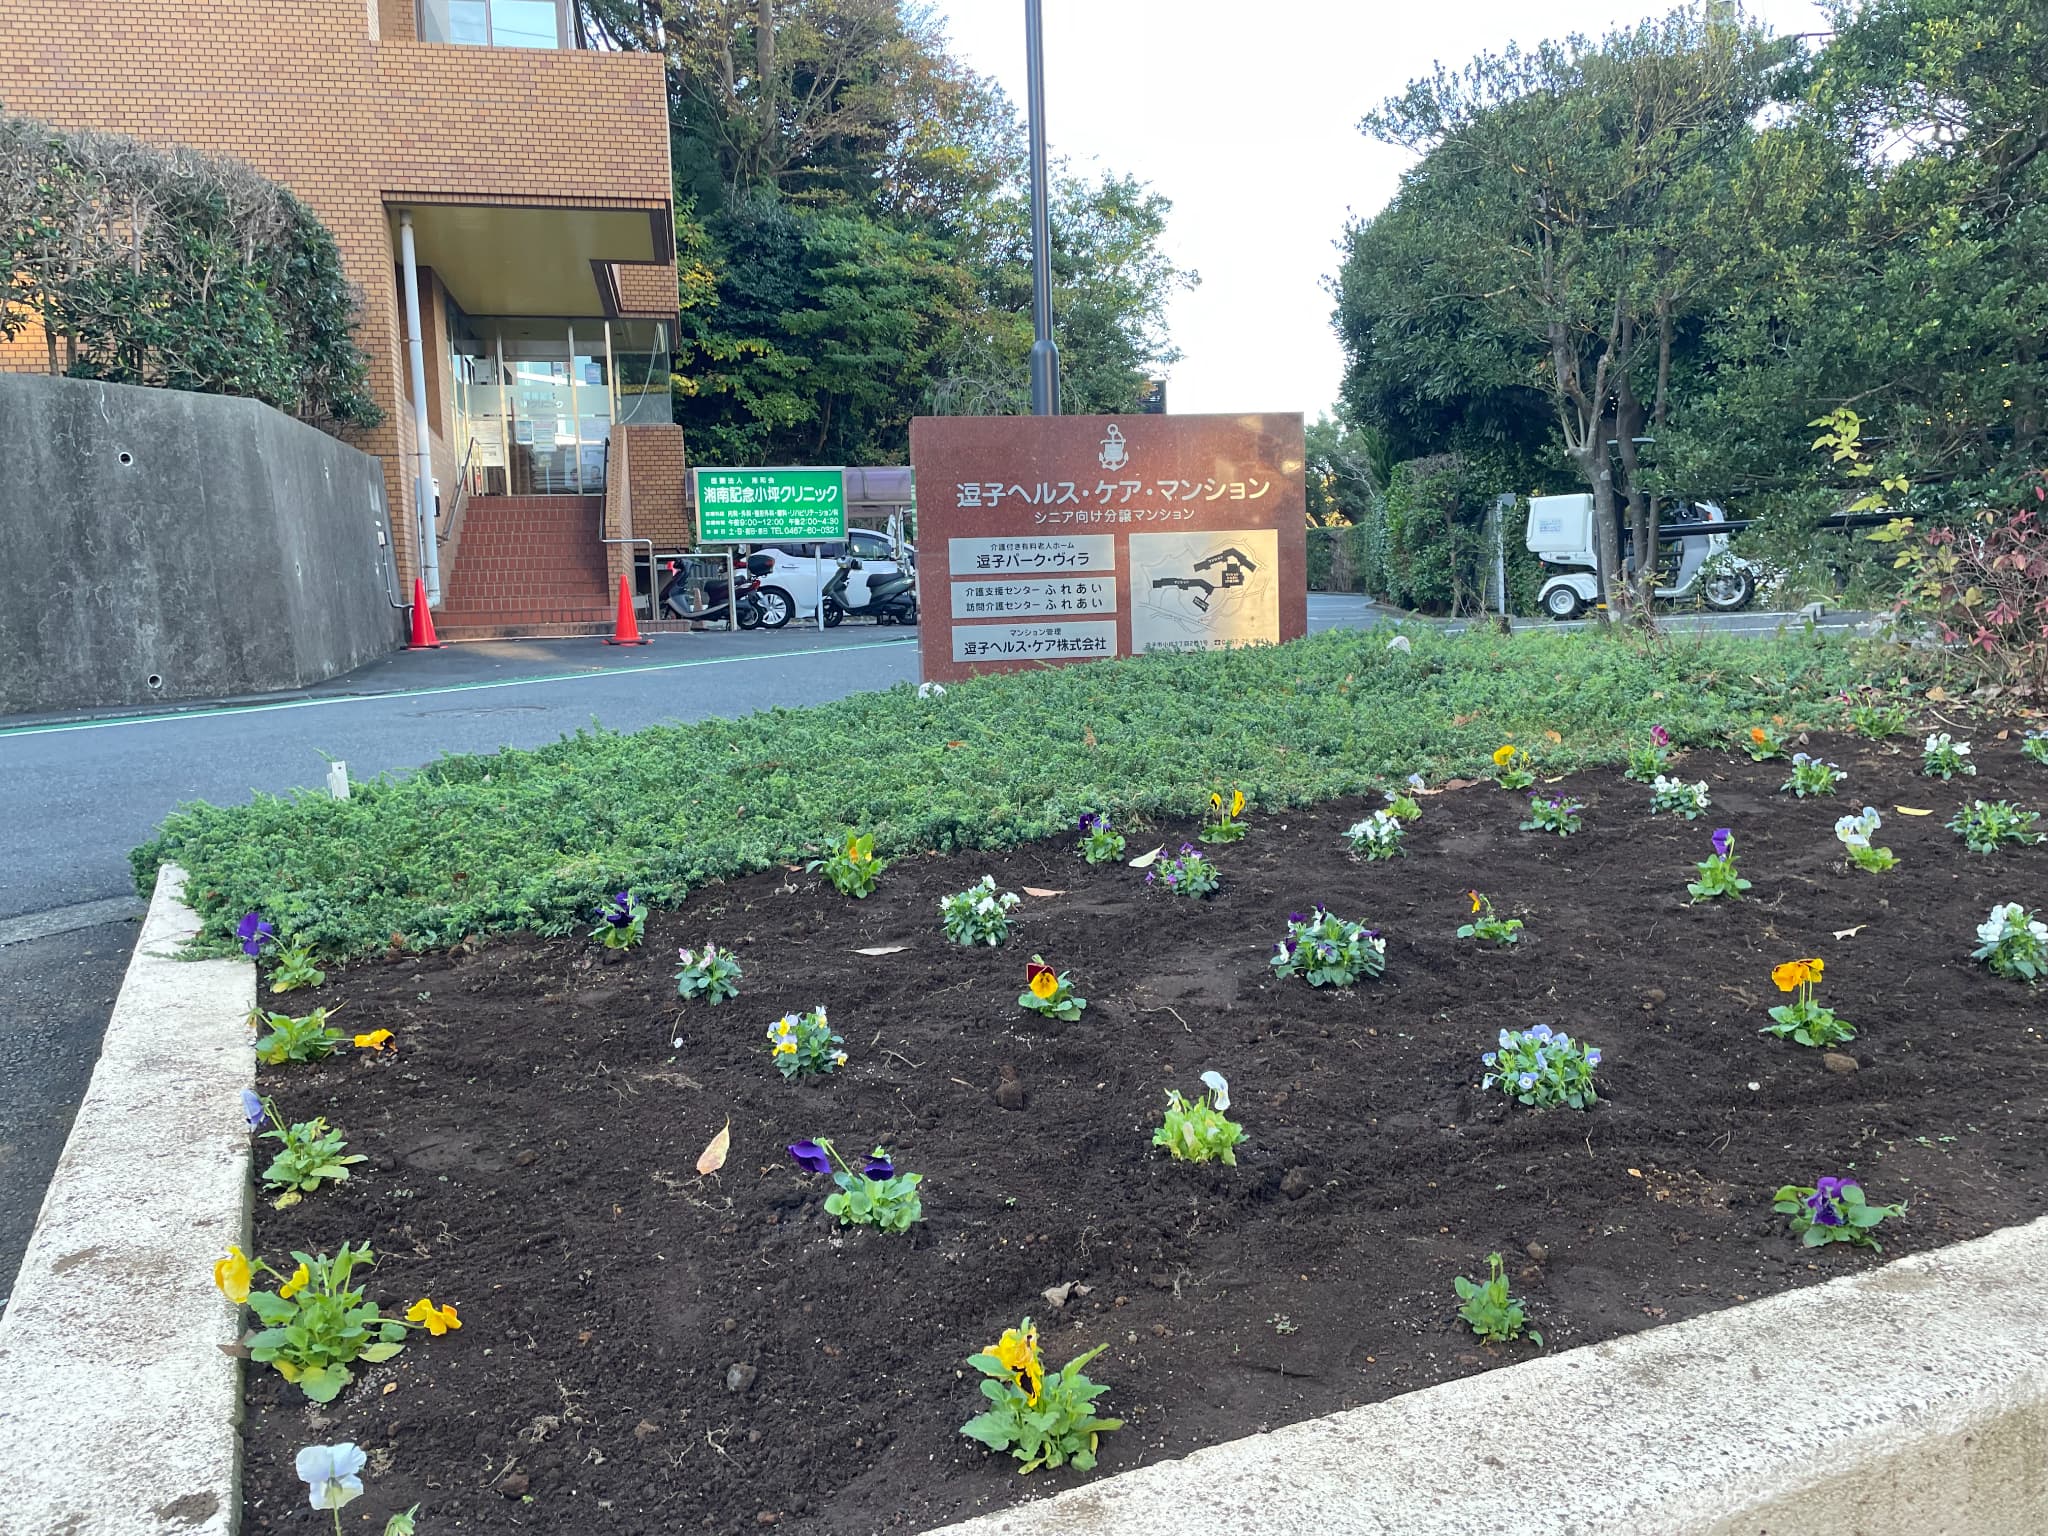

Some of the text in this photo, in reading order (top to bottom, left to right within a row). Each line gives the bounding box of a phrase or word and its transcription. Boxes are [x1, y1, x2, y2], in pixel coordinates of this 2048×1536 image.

[703, 485, 838, 504] 湘南記念小坪クリニック
[956, 477, 1271, 509] 逗子ヘルス・ケア・マンション
[1034, 508, 1195, 525] シニア向け分譲マンション
[990, 541, 1075, 552] 介護付き有料老人ホーム
[976, 551, 1090, 569] 逗子パーク・ヴィラ
[965, 586, 1040, 597] 介護支援センター
[966, 601, 1041, 612] 訪問介護センター
[1009, 627, 1062, 637] マンション管理
[964, 636, 1107, 656] 逗子ヘルス・ケア株式会社
